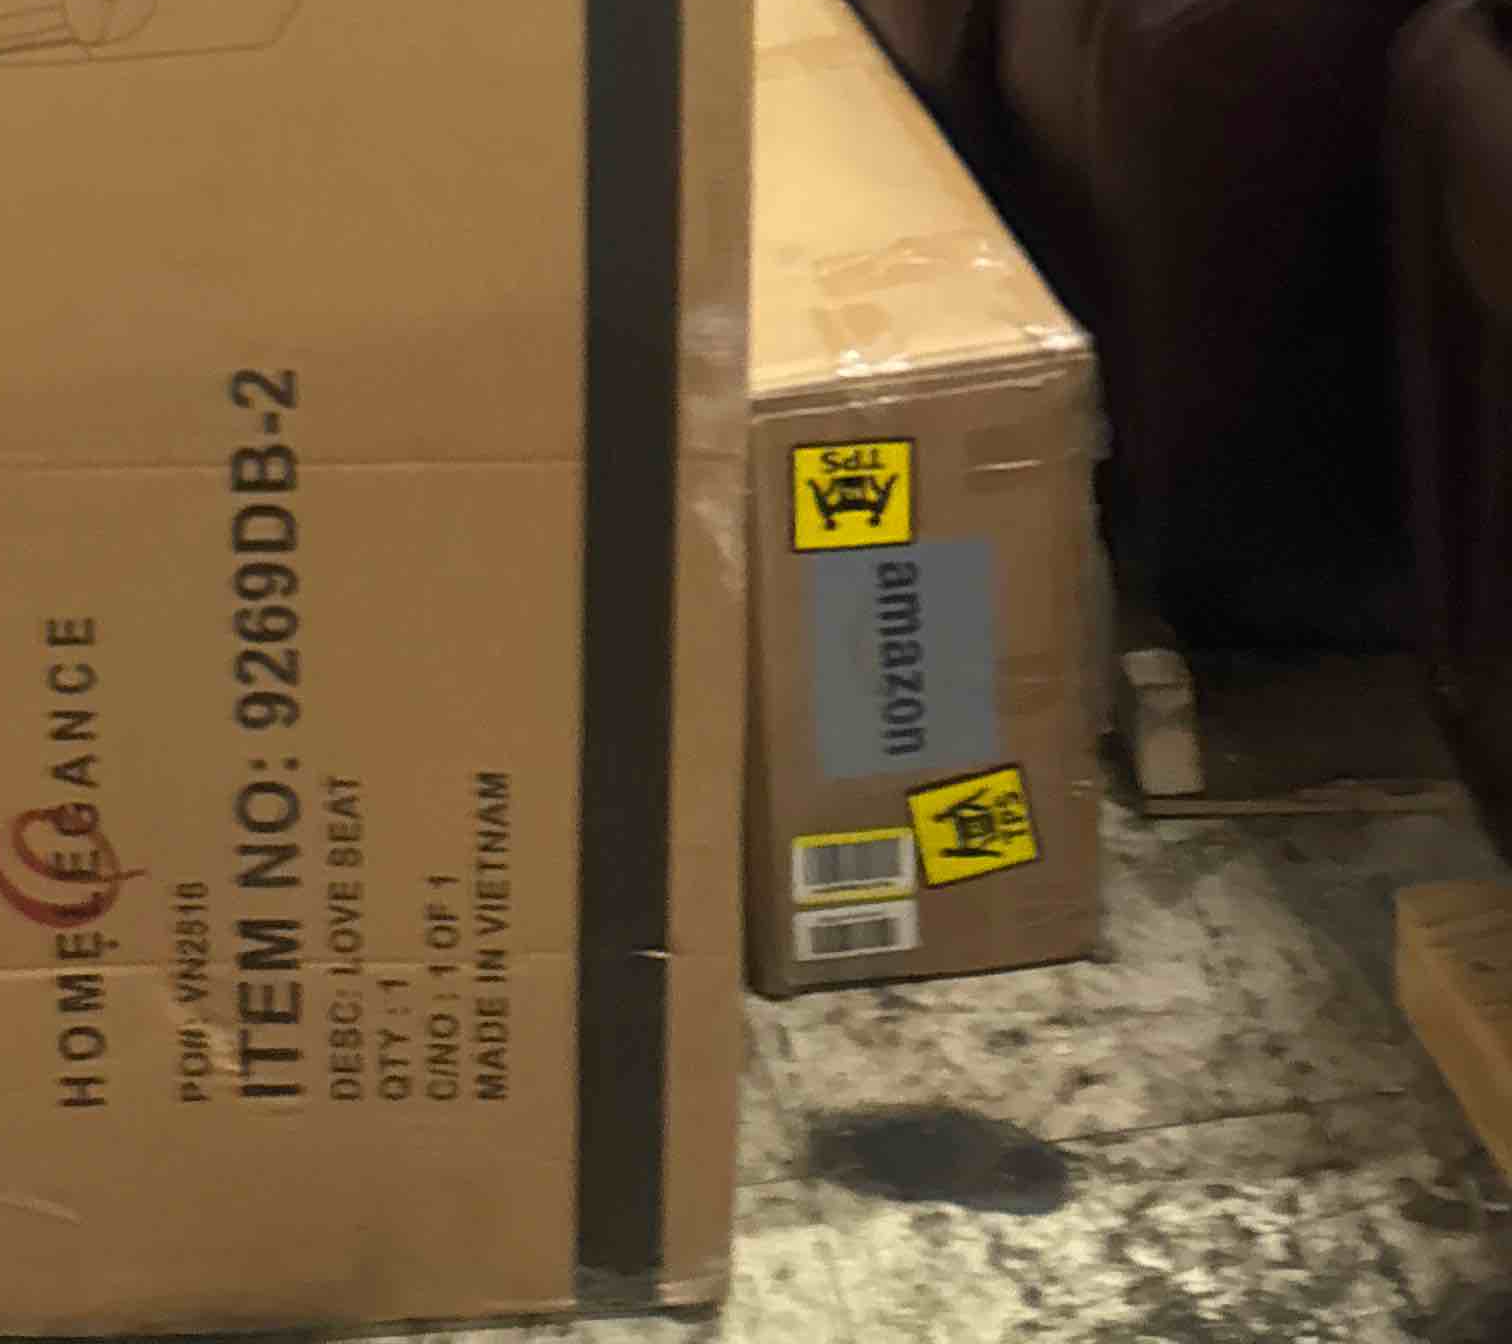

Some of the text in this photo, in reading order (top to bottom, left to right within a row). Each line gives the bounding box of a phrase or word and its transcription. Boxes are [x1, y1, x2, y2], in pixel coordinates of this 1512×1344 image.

[820, 448, 885, 473] TPS
[876, 562, 927, 756] amazon
[232, 369, 303, 1097] ITEM NO: 9269DB-2
[46, 617, 108, 1108] HOMELEGANCE
[327, 776, 363, 867] SEAT
[329, 881, 364, 975] LOVE
[426, 903, 461, 950] OF
[474, 772, 511, 1101] MADE IN VIETNAM
